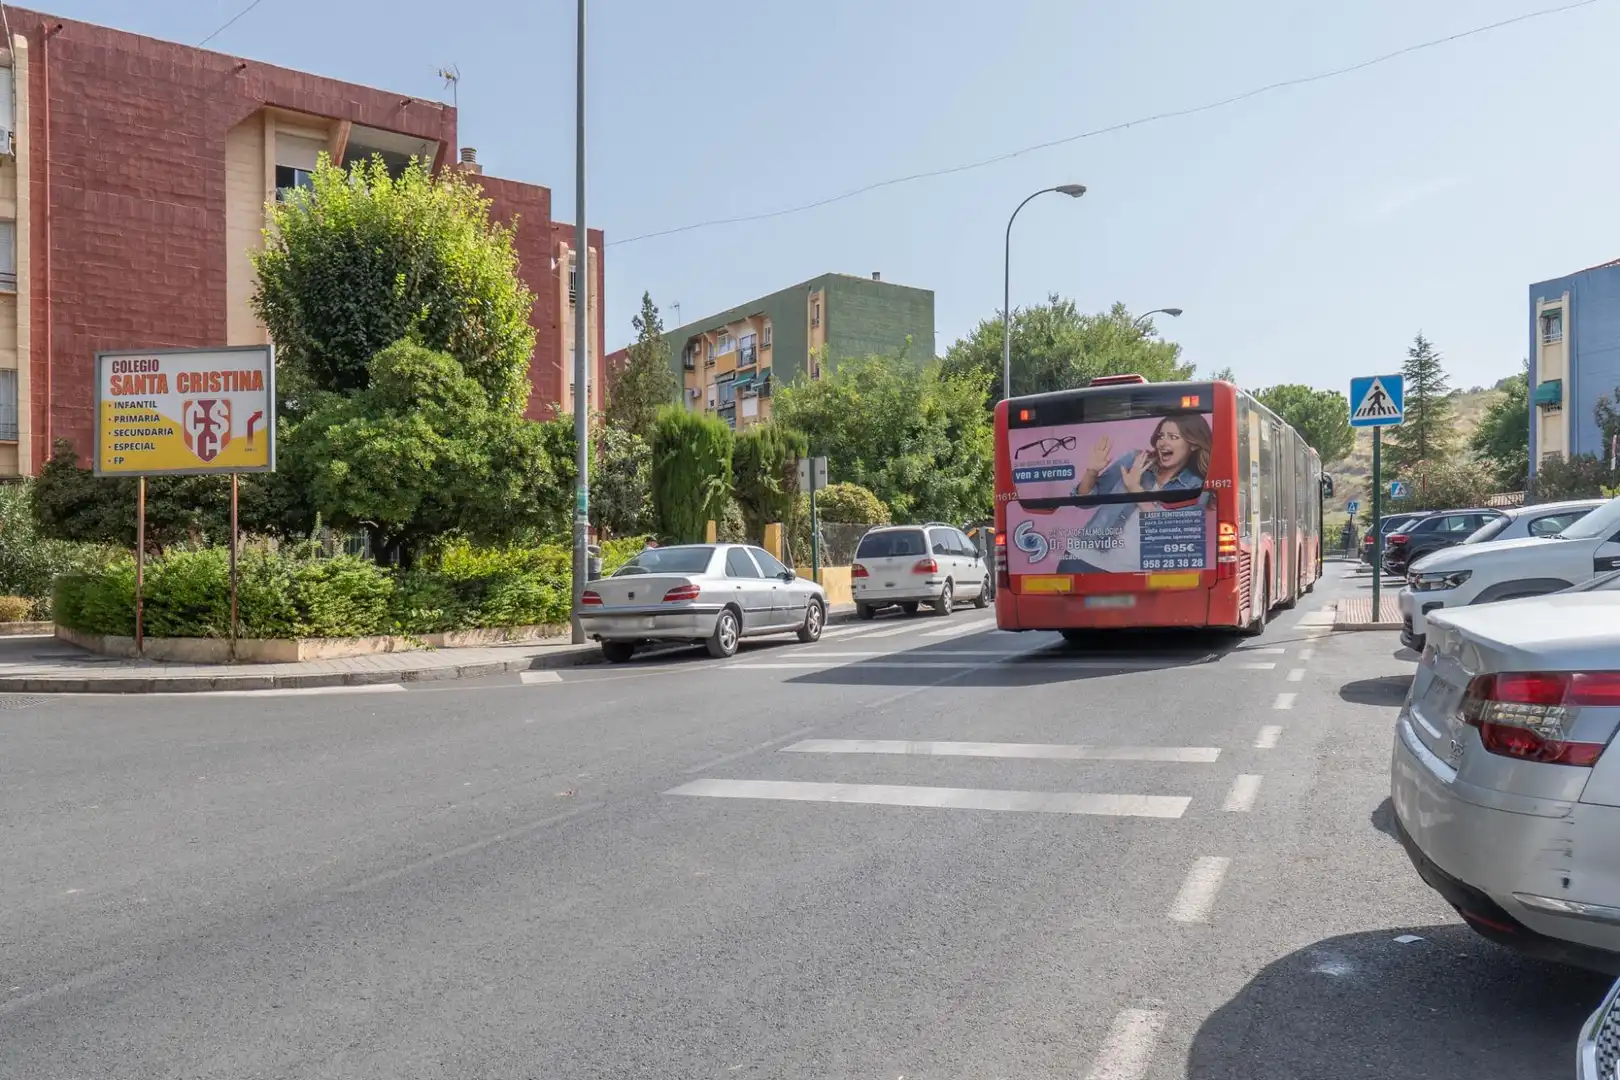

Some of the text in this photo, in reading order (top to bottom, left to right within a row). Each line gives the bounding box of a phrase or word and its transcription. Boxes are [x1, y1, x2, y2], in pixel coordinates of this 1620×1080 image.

[112, 359, 159, 373] COLEGIO
[110, 370, 264, 396] SANTA CRISTINA
[114, 400, 158, 409] INFANTIL
[114, 414, 160, 423] PRIMARIA
[113, 427, 174, 437] SECUNDARIA
[114, 442, 156, 451] ESPECIAL
[113, 456, 125, 464] FP
[1015, 468, 1073, 480] ven a vernos
[1204, 479, 1232, 489] 11612
[1049, 537, 1125, 550] Dr. Benavides
[1163, 543, 1195, 553] 695€
[1143, 558, 1204, 569] 958 28 38 28
